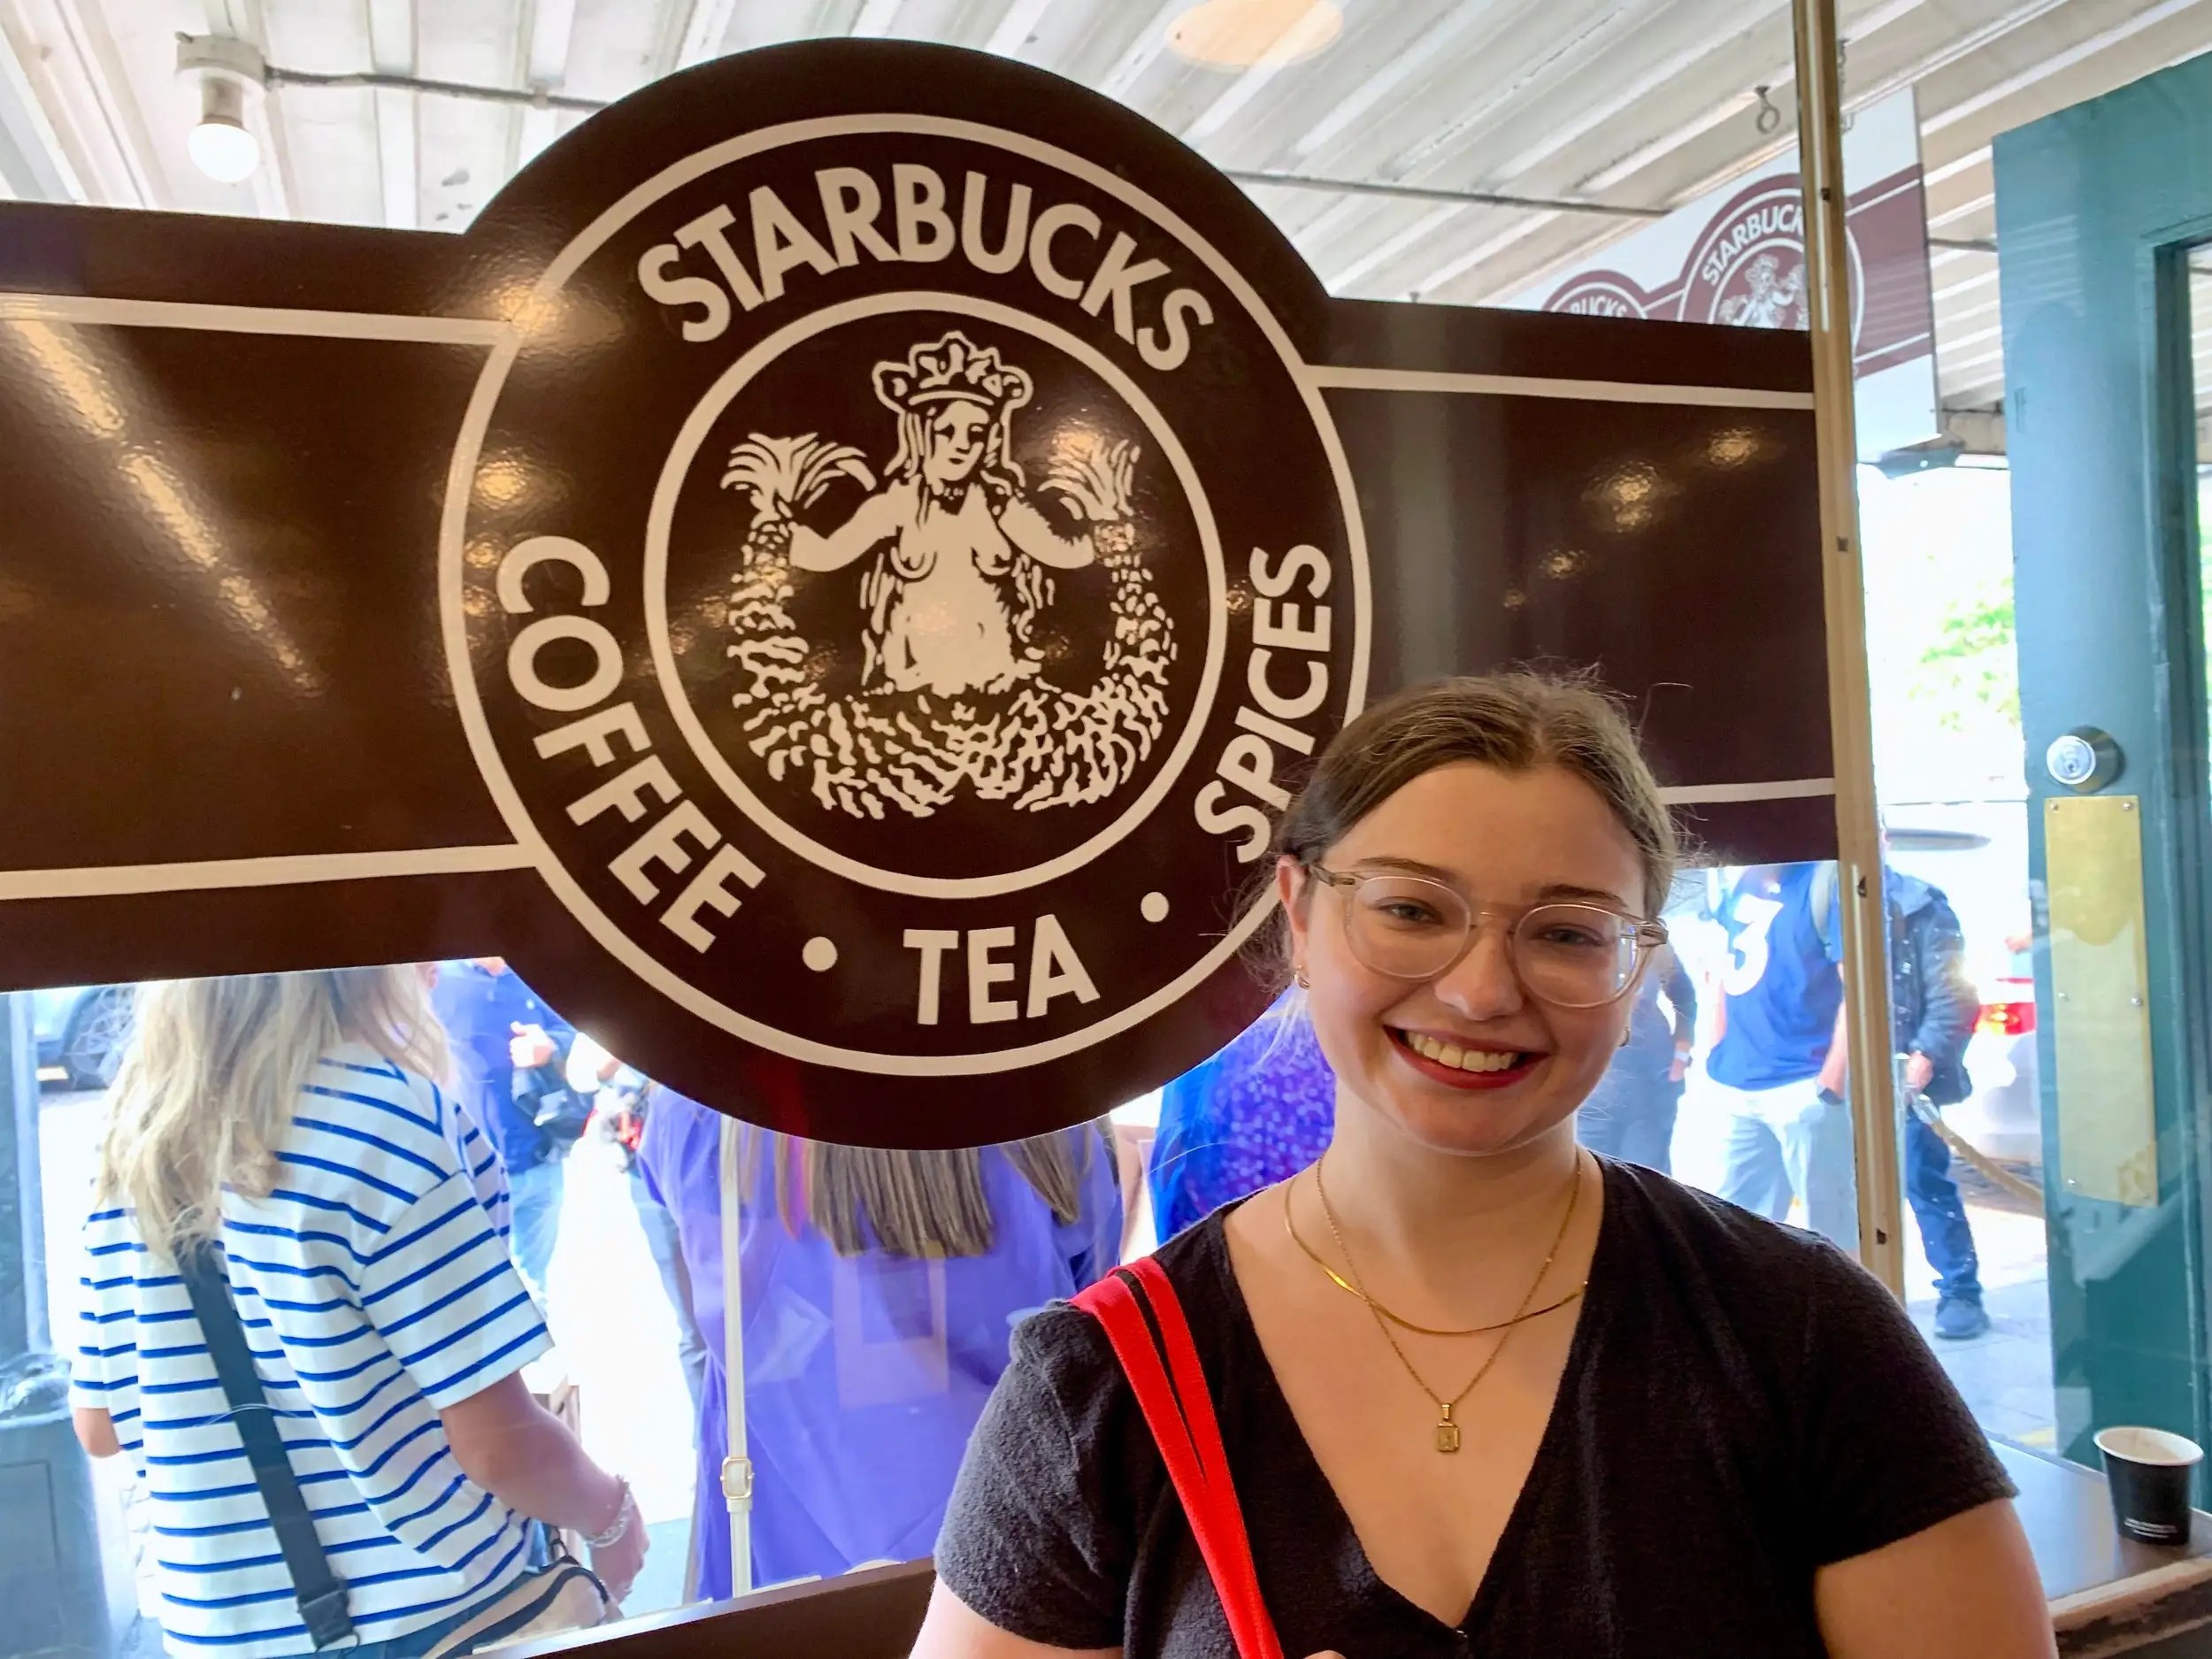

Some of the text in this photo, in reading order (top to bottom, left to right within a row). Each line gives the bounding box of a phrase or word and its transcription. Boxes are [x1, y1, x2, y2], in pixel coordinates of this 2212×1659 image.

[638, 163, 1213, 372] STARBUCKS
[1701, 204, 1805, 288] STARBUC
[496, 534, 766, 954] COFFEE
[1194, 543, 1332, 864] SPICES
[902, 913, 1100, 1026] TEA
[1721, 892, 1784, 997] 3
